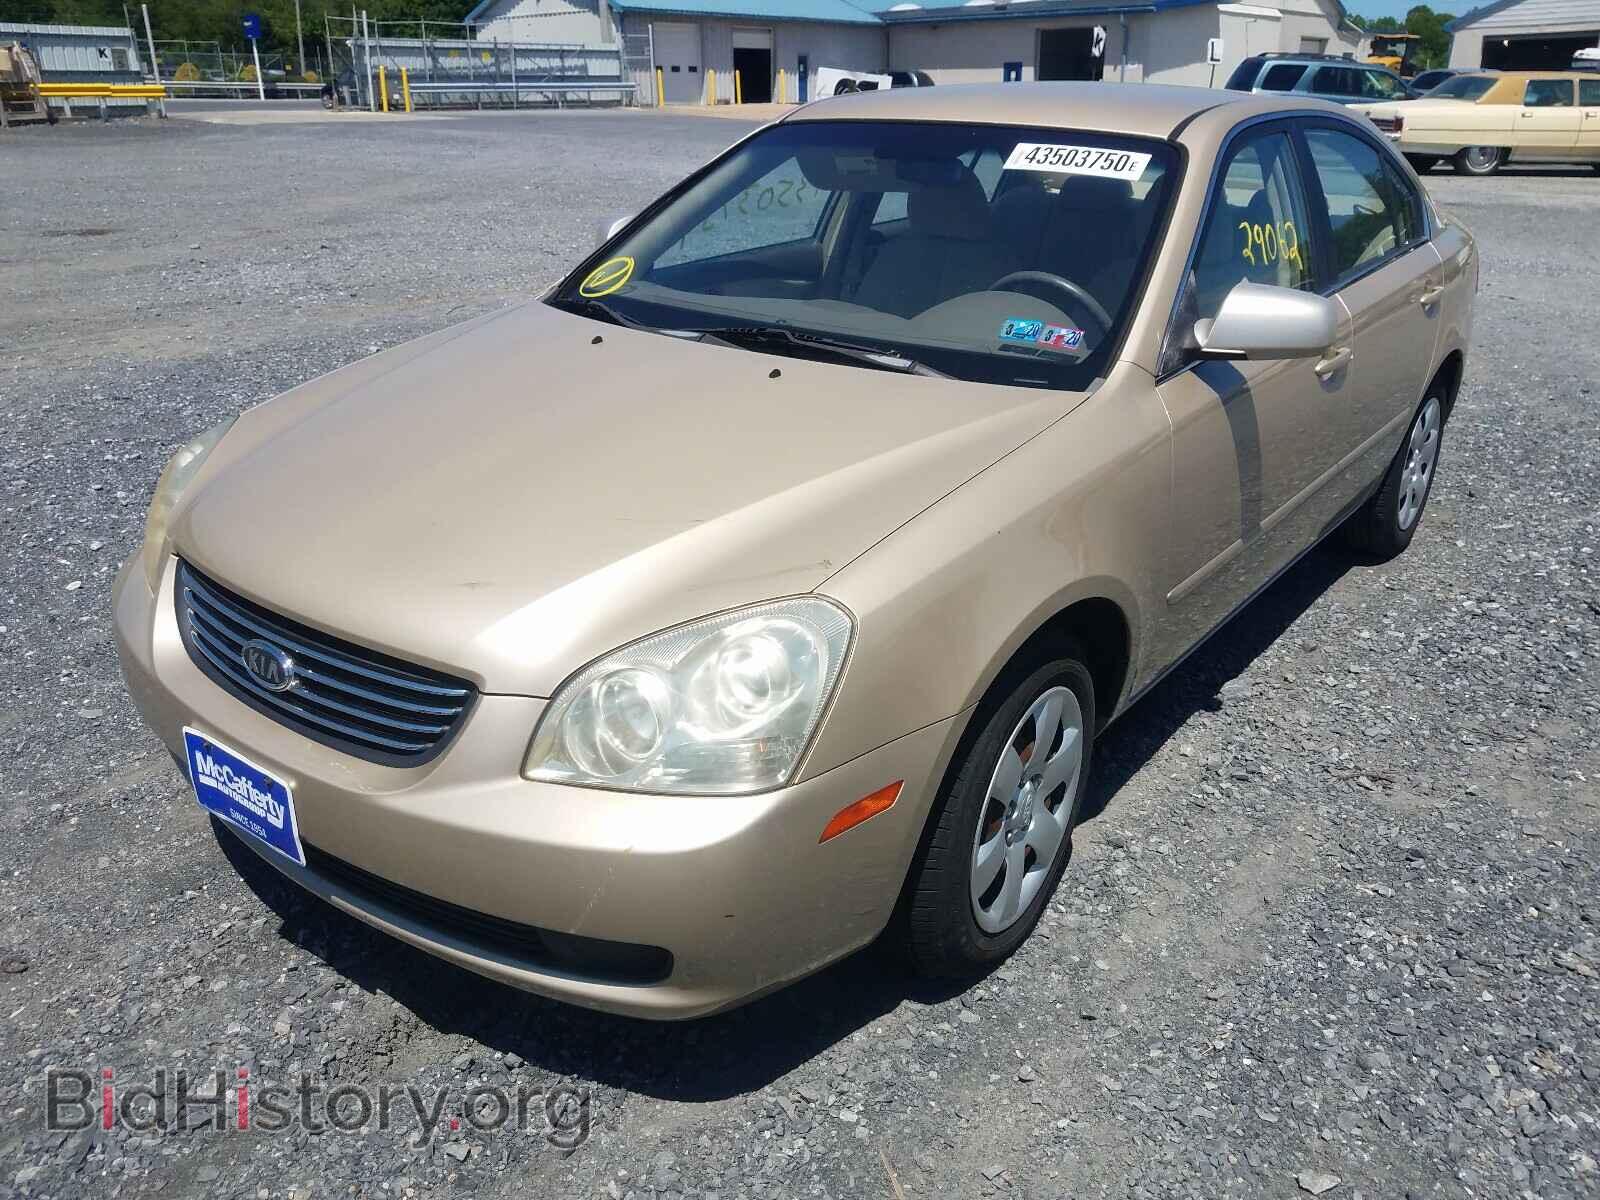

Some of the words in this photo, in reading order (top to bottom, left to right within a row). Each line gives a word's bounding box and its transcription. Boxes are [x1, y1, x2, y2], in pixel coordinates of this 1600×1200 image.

[98, 48, 108, 58] K
[1210, 41, 1220, 62] L
[1238, 221, 1304, 270] 29062
[248, 649, 280, 684] KIA
[195, 750, 284, 829] McCafferty
[229, 808, 249, 828] SINCE
